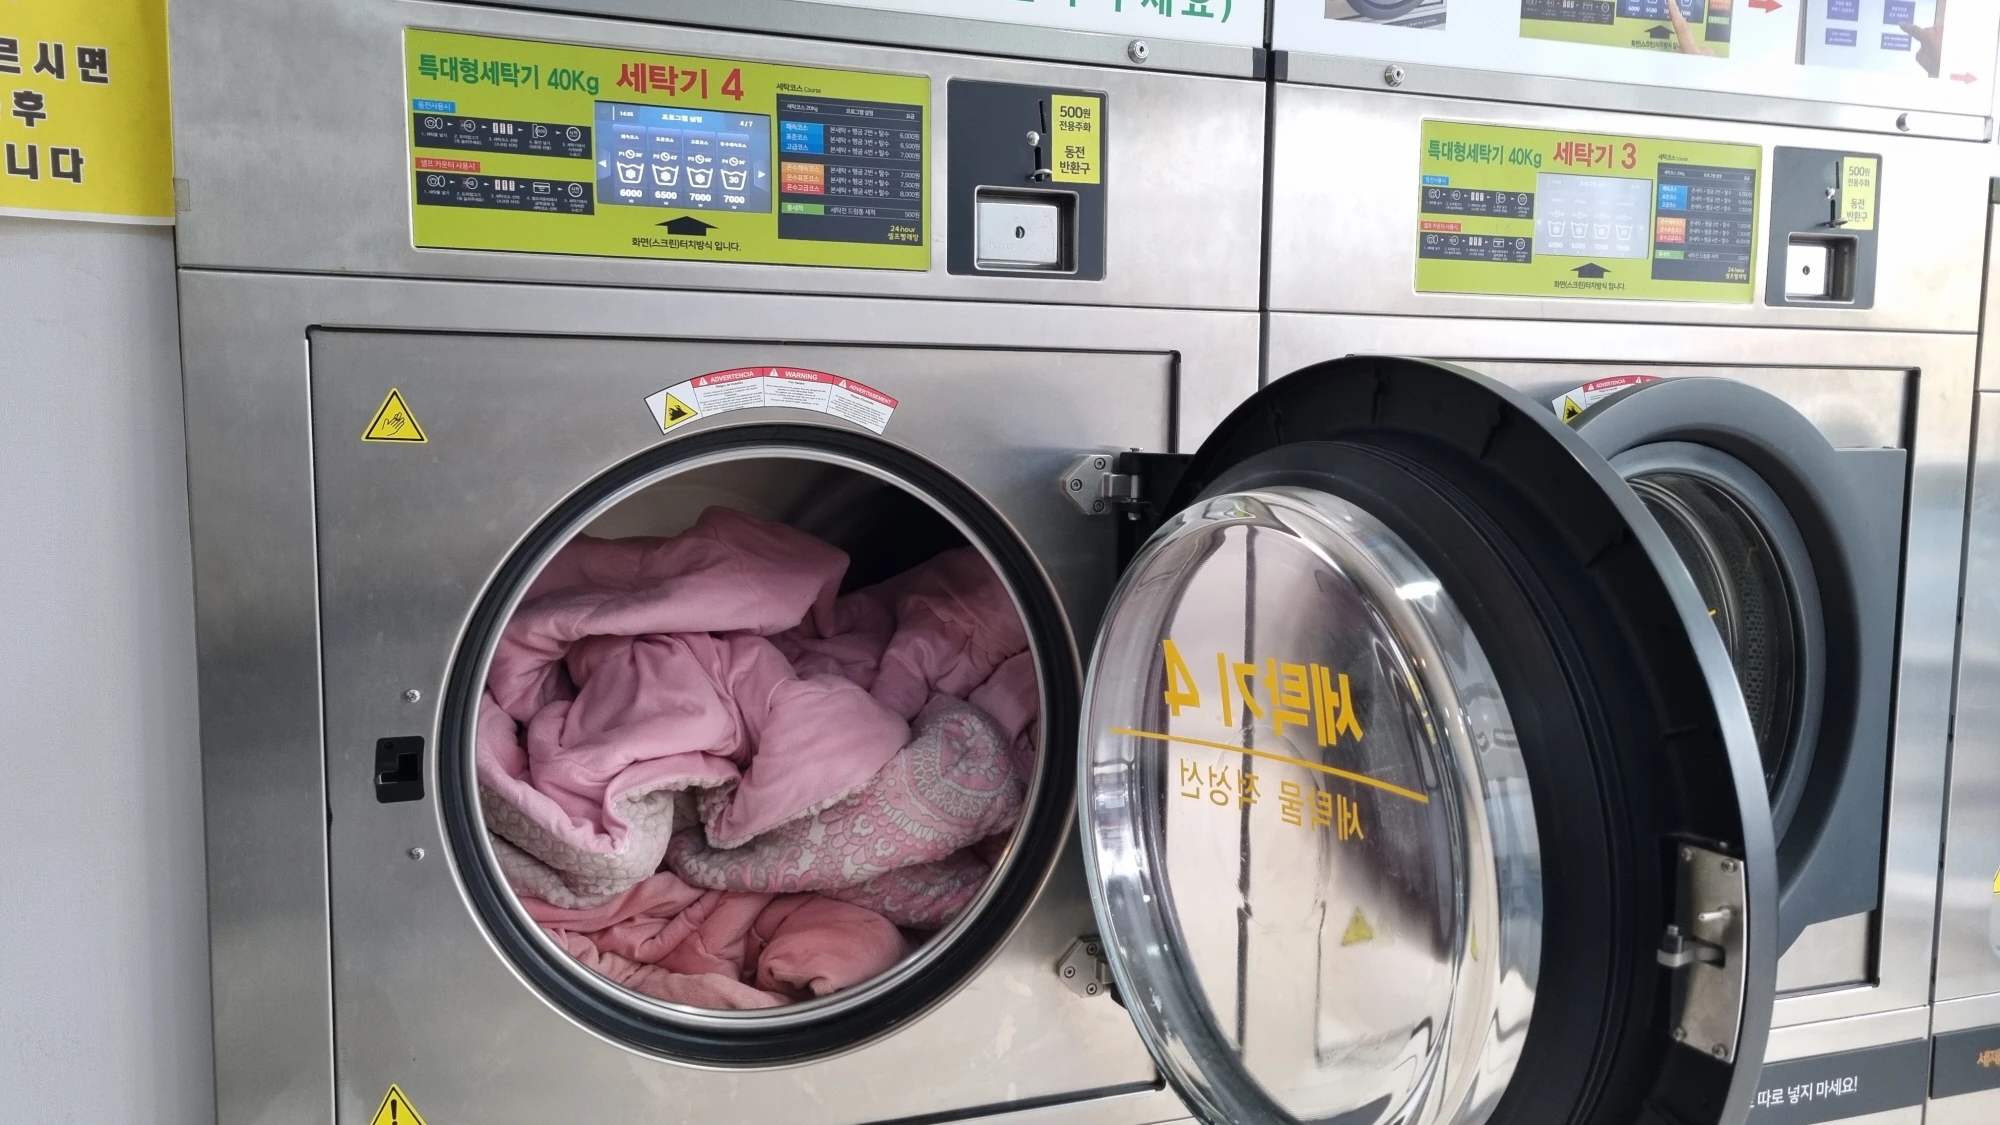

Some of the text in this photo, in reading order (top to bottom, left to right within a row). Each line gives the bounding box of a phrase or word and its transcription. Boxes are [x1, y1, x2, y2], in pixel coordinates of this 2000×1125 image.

[417, 53, 745, 101] 특대형세탁기 40Kg 세탁기 4
[776, 83, 822, 94] 세탁코스 Course
[13, 91, 46, 127] 후
[787, 103, 805, 111] 세탁코스
[1059, 106, 1091, 120] 500원
[1059, 121, 1092, 133] 전용주화
[900, 132, 920, 140] 6,000원
[900, 142, 920, 150] 6,500원
[900, 152, 920, 160] 7,000원
[1065, 146, 1085, 159] 동전
[1428, 139, 1637, 170] 특대형세탁기 40Kg 세탁기 3
[6, 143, 83, 183] 니다
[1059, 161, 1090, 176] 반환구
[900, 172, 920, 180] 7,000원
[1849, 166, 1870, 176] 500원
[900, 182, 920, 190] 7,500원
[1848, 178, 1870, 187] 전용주화
[620, 189, 745, 204] 6000 6500 7000 7000
[900, 191, 920, 199] 8,000원
[1851, 198, 1865, 209] 동전
[905, 211, 920, 219] 500원
[1847, 211, 1868, 222] 반환구
[631, 237, 741, 252] 화면(스크린)터치방식 입니다.
[710, 371, 754, 383] ADVERTENCIA
[785, 371, 818, 382] WARNING
[1596, 378, 1625, 389] ADVERTENCIA
[849, 384, 891, 406] ADVERTISSEMENT
[1757, 1090, 1784, 1108] 따로
[1787, 1083, 1813, 1104] 넣지
[1816, 1076, 1859, 1098] 마세요!
